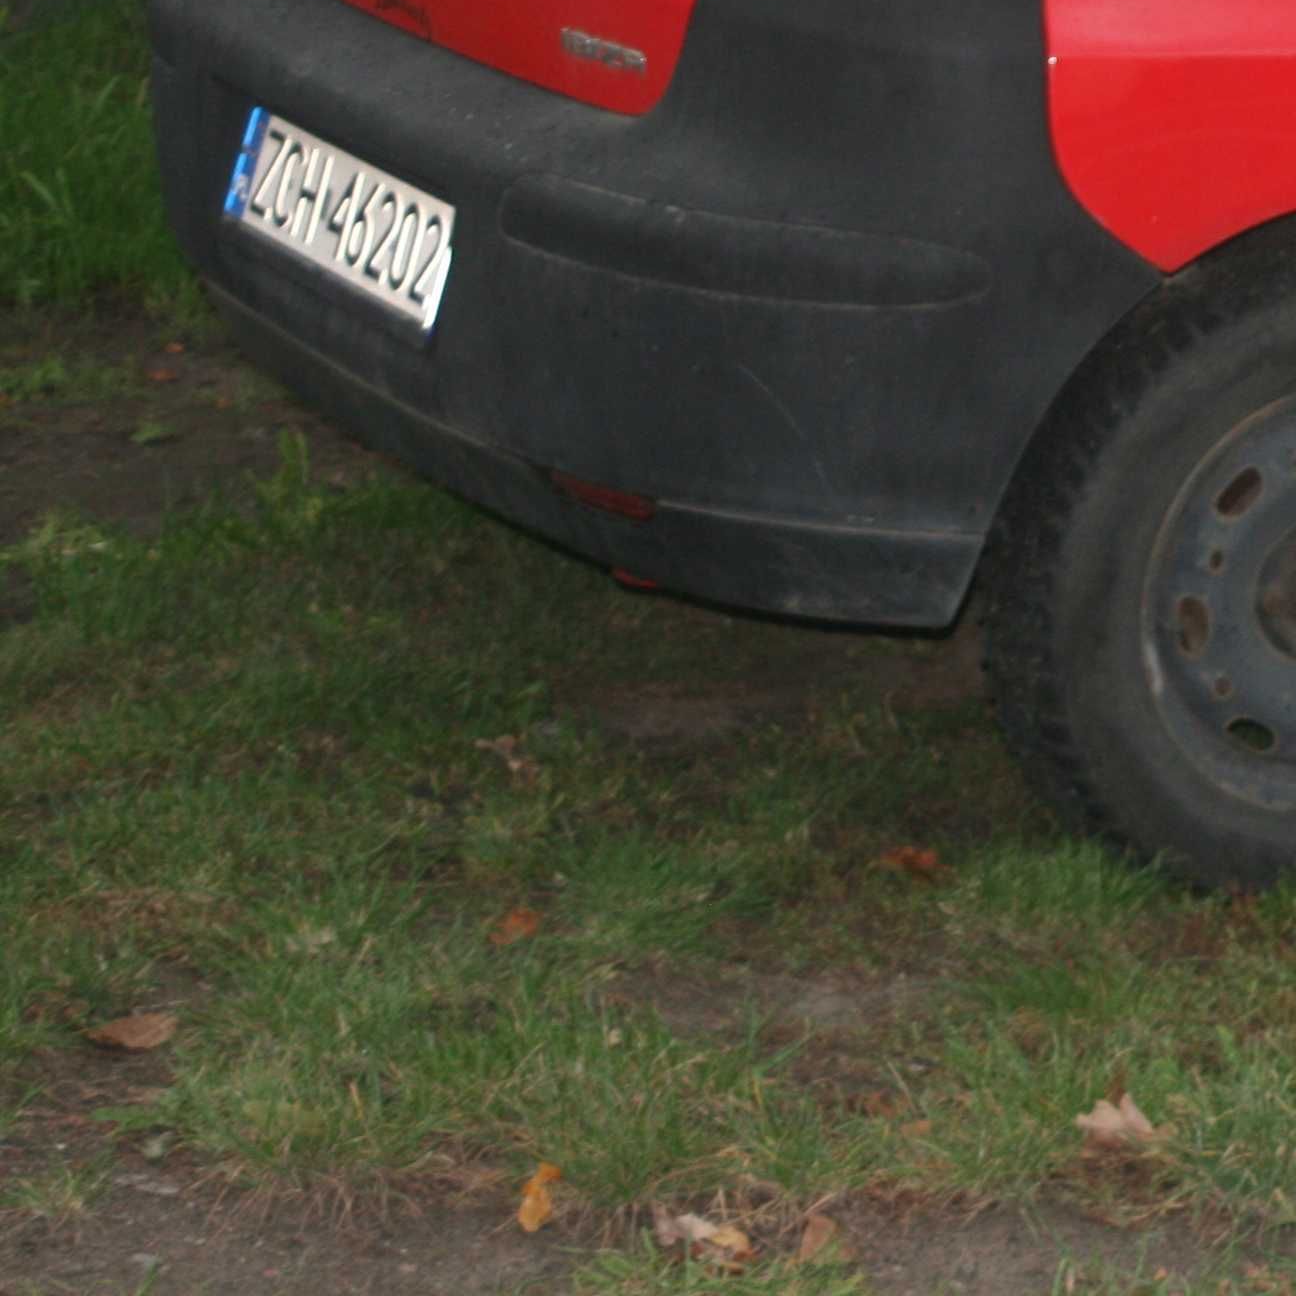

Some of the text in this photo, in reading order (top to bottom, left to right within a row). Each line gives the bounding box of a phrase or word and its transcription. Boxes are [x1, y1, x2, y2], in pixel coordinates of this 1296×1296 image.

[561, 27, 647, 73] IBIZA
[251, 130, 449, 313] ZCH 46202
